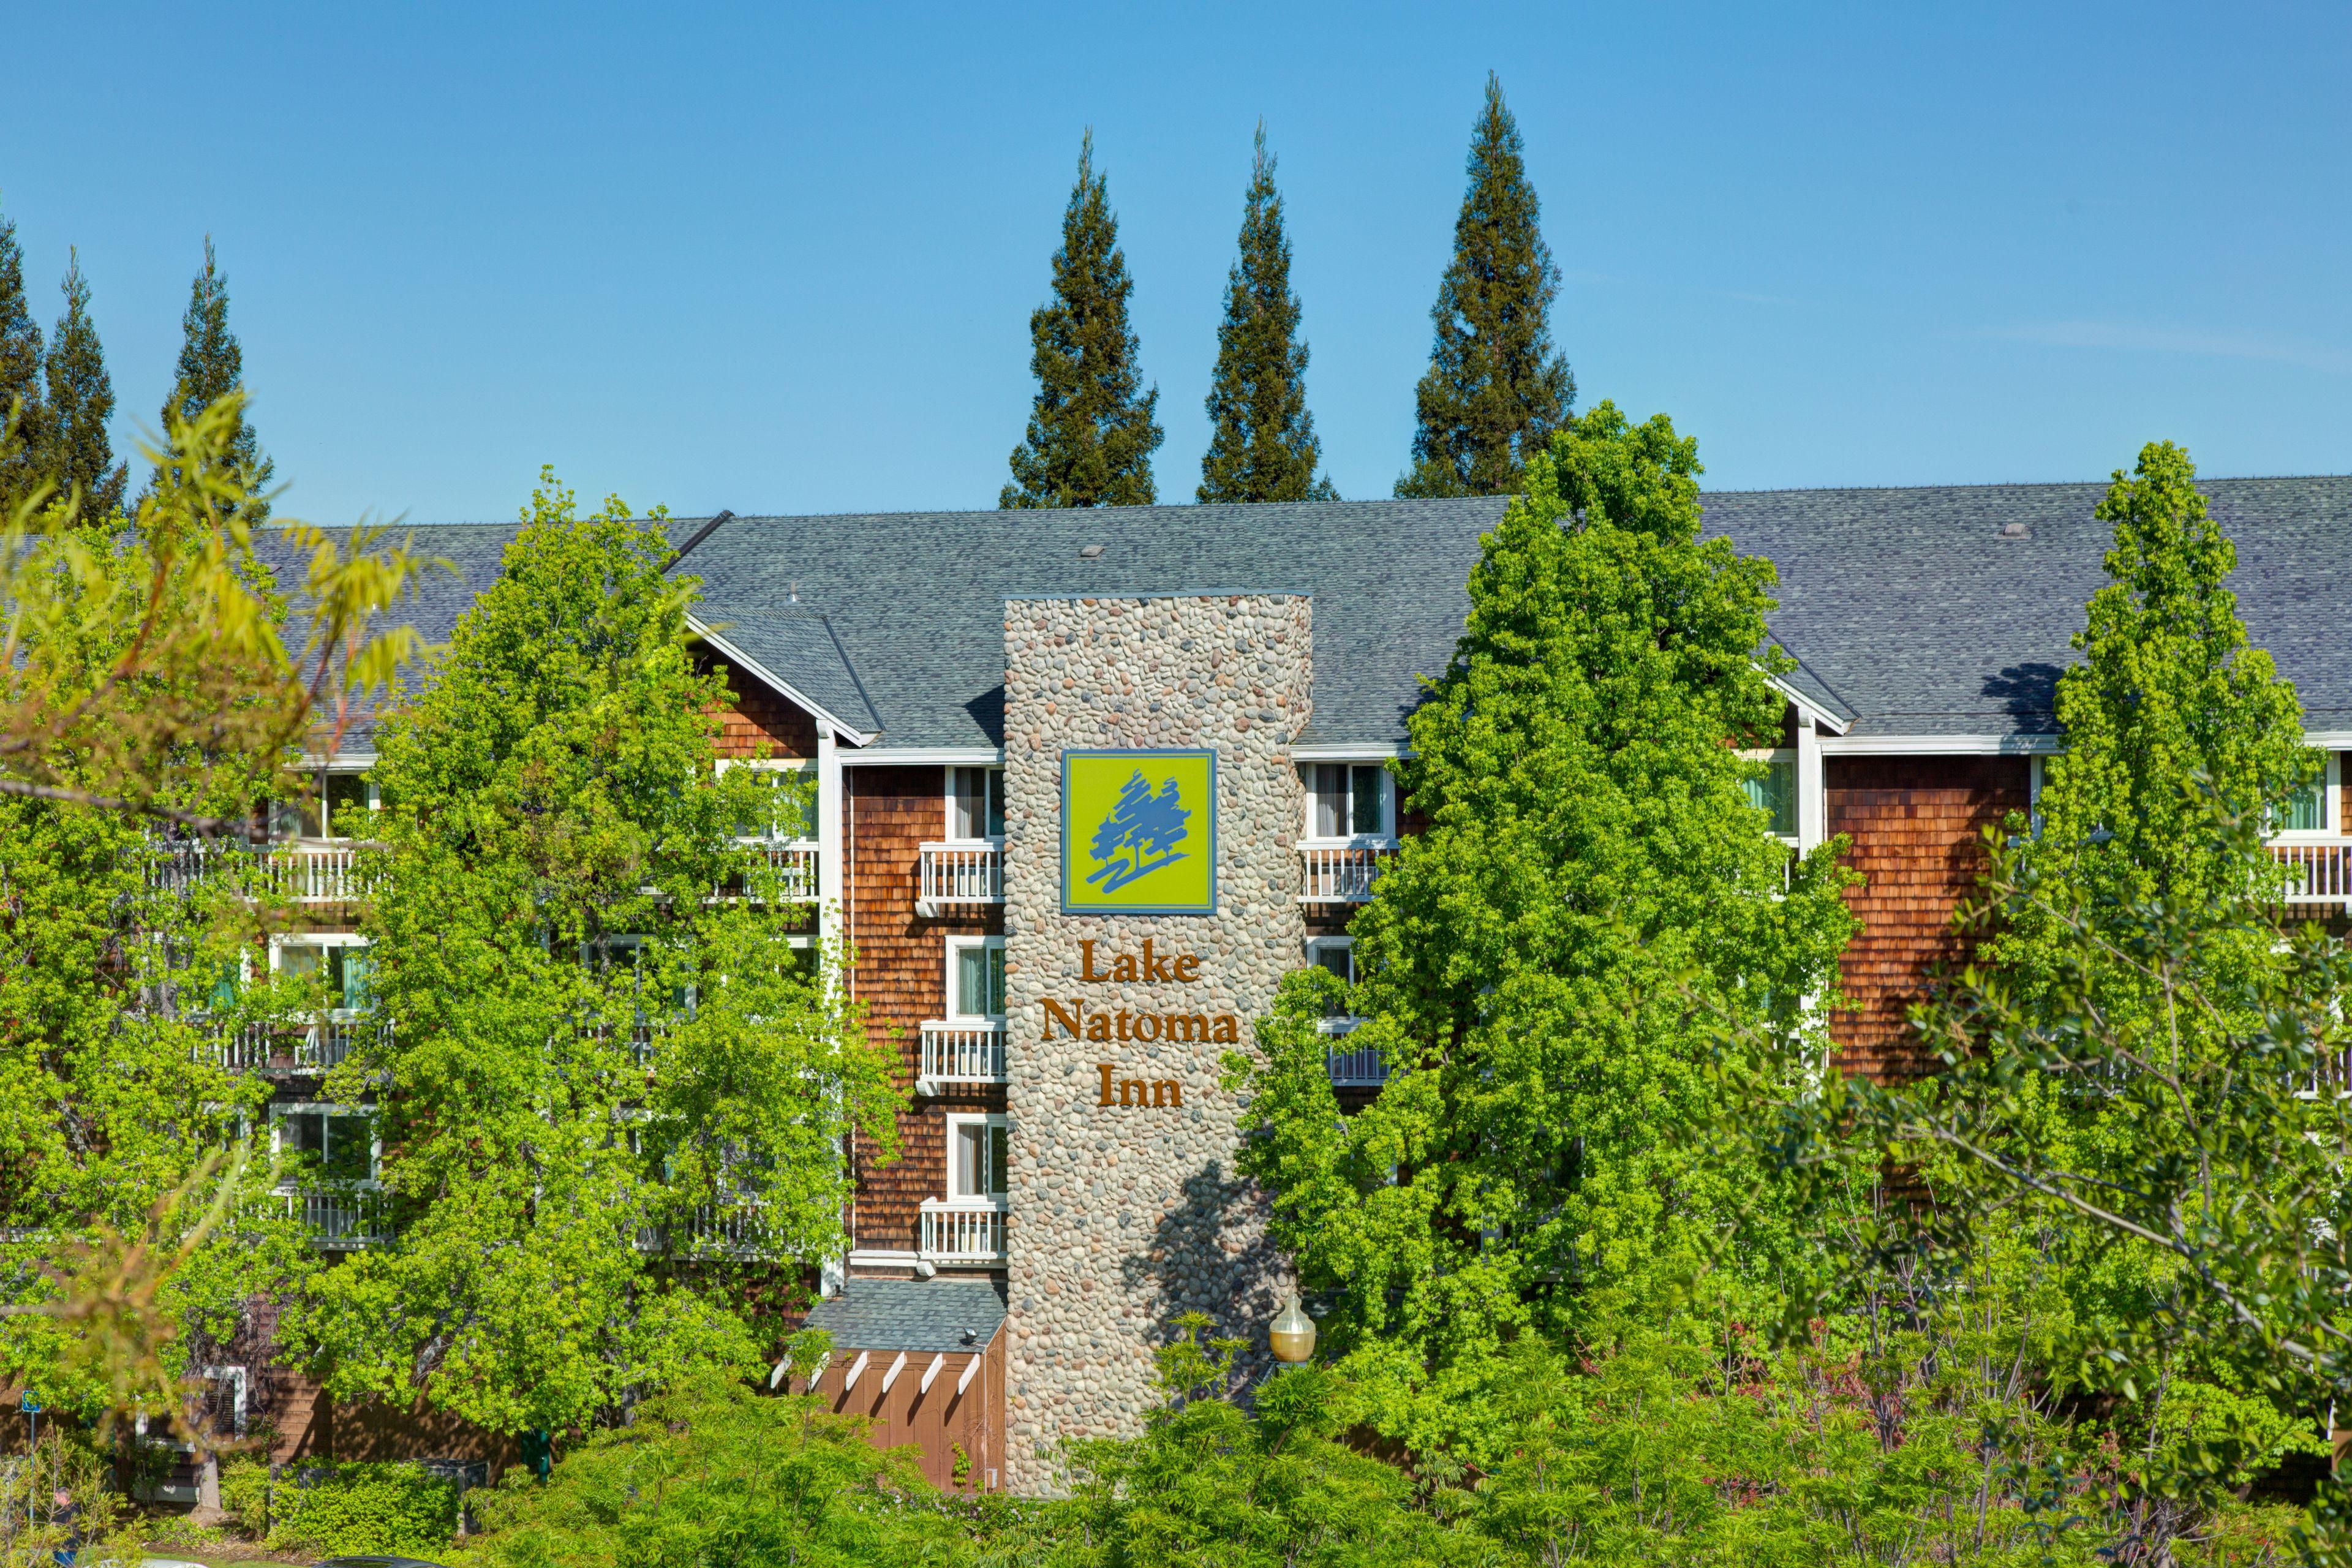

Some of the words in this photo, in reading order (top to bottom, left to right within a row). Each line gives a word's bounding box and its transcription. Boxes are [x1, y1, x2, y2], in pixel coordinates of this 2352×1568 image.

[1078, 938, 1200, 982] Lake
[1040, 998, 1240, 1042] Natoma
[1096, 1064, 1183, 1107] Inn
